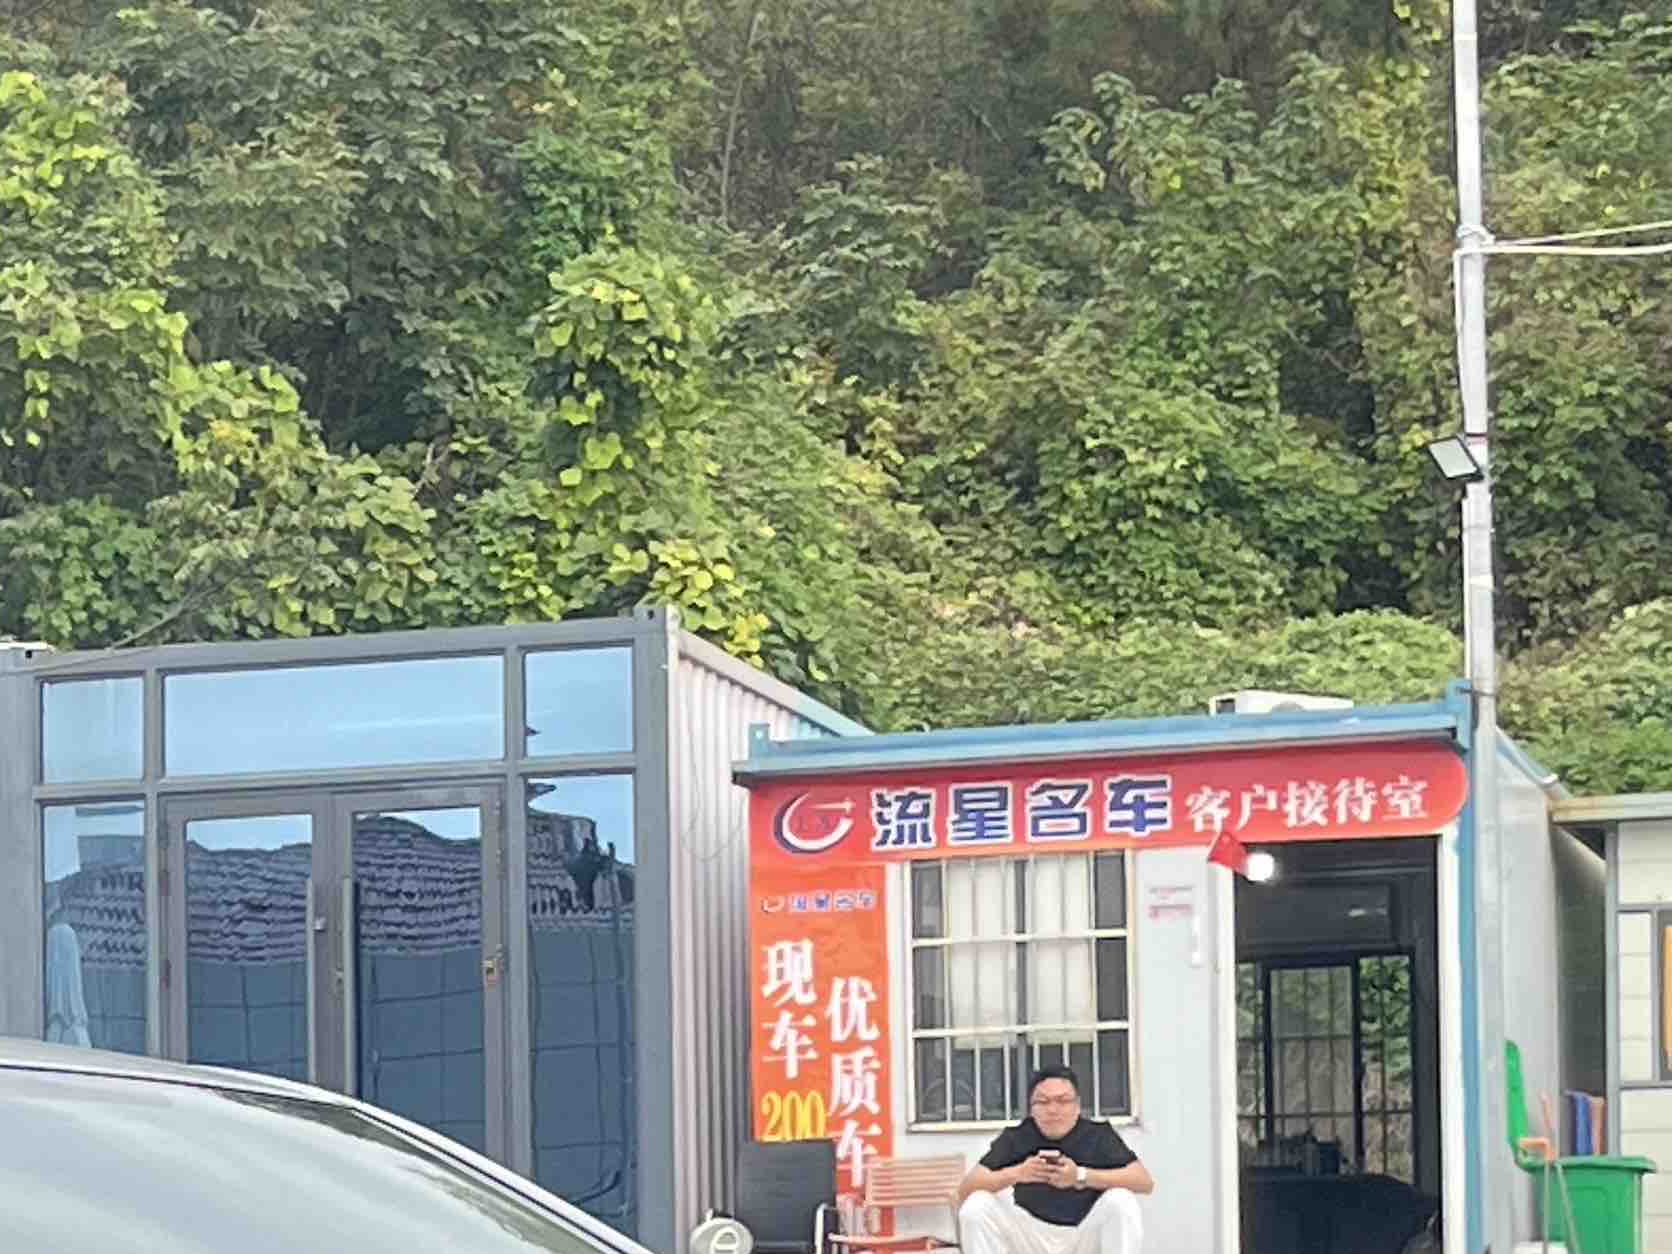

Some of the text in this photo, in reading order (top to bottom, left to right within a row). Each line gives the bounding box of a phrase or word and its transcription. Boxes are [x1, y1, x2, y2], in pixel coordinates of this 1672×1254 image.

[871, 775, 1428, 851] 流星名车 客户接待室
[761, 938, 818, 1079] 现车
